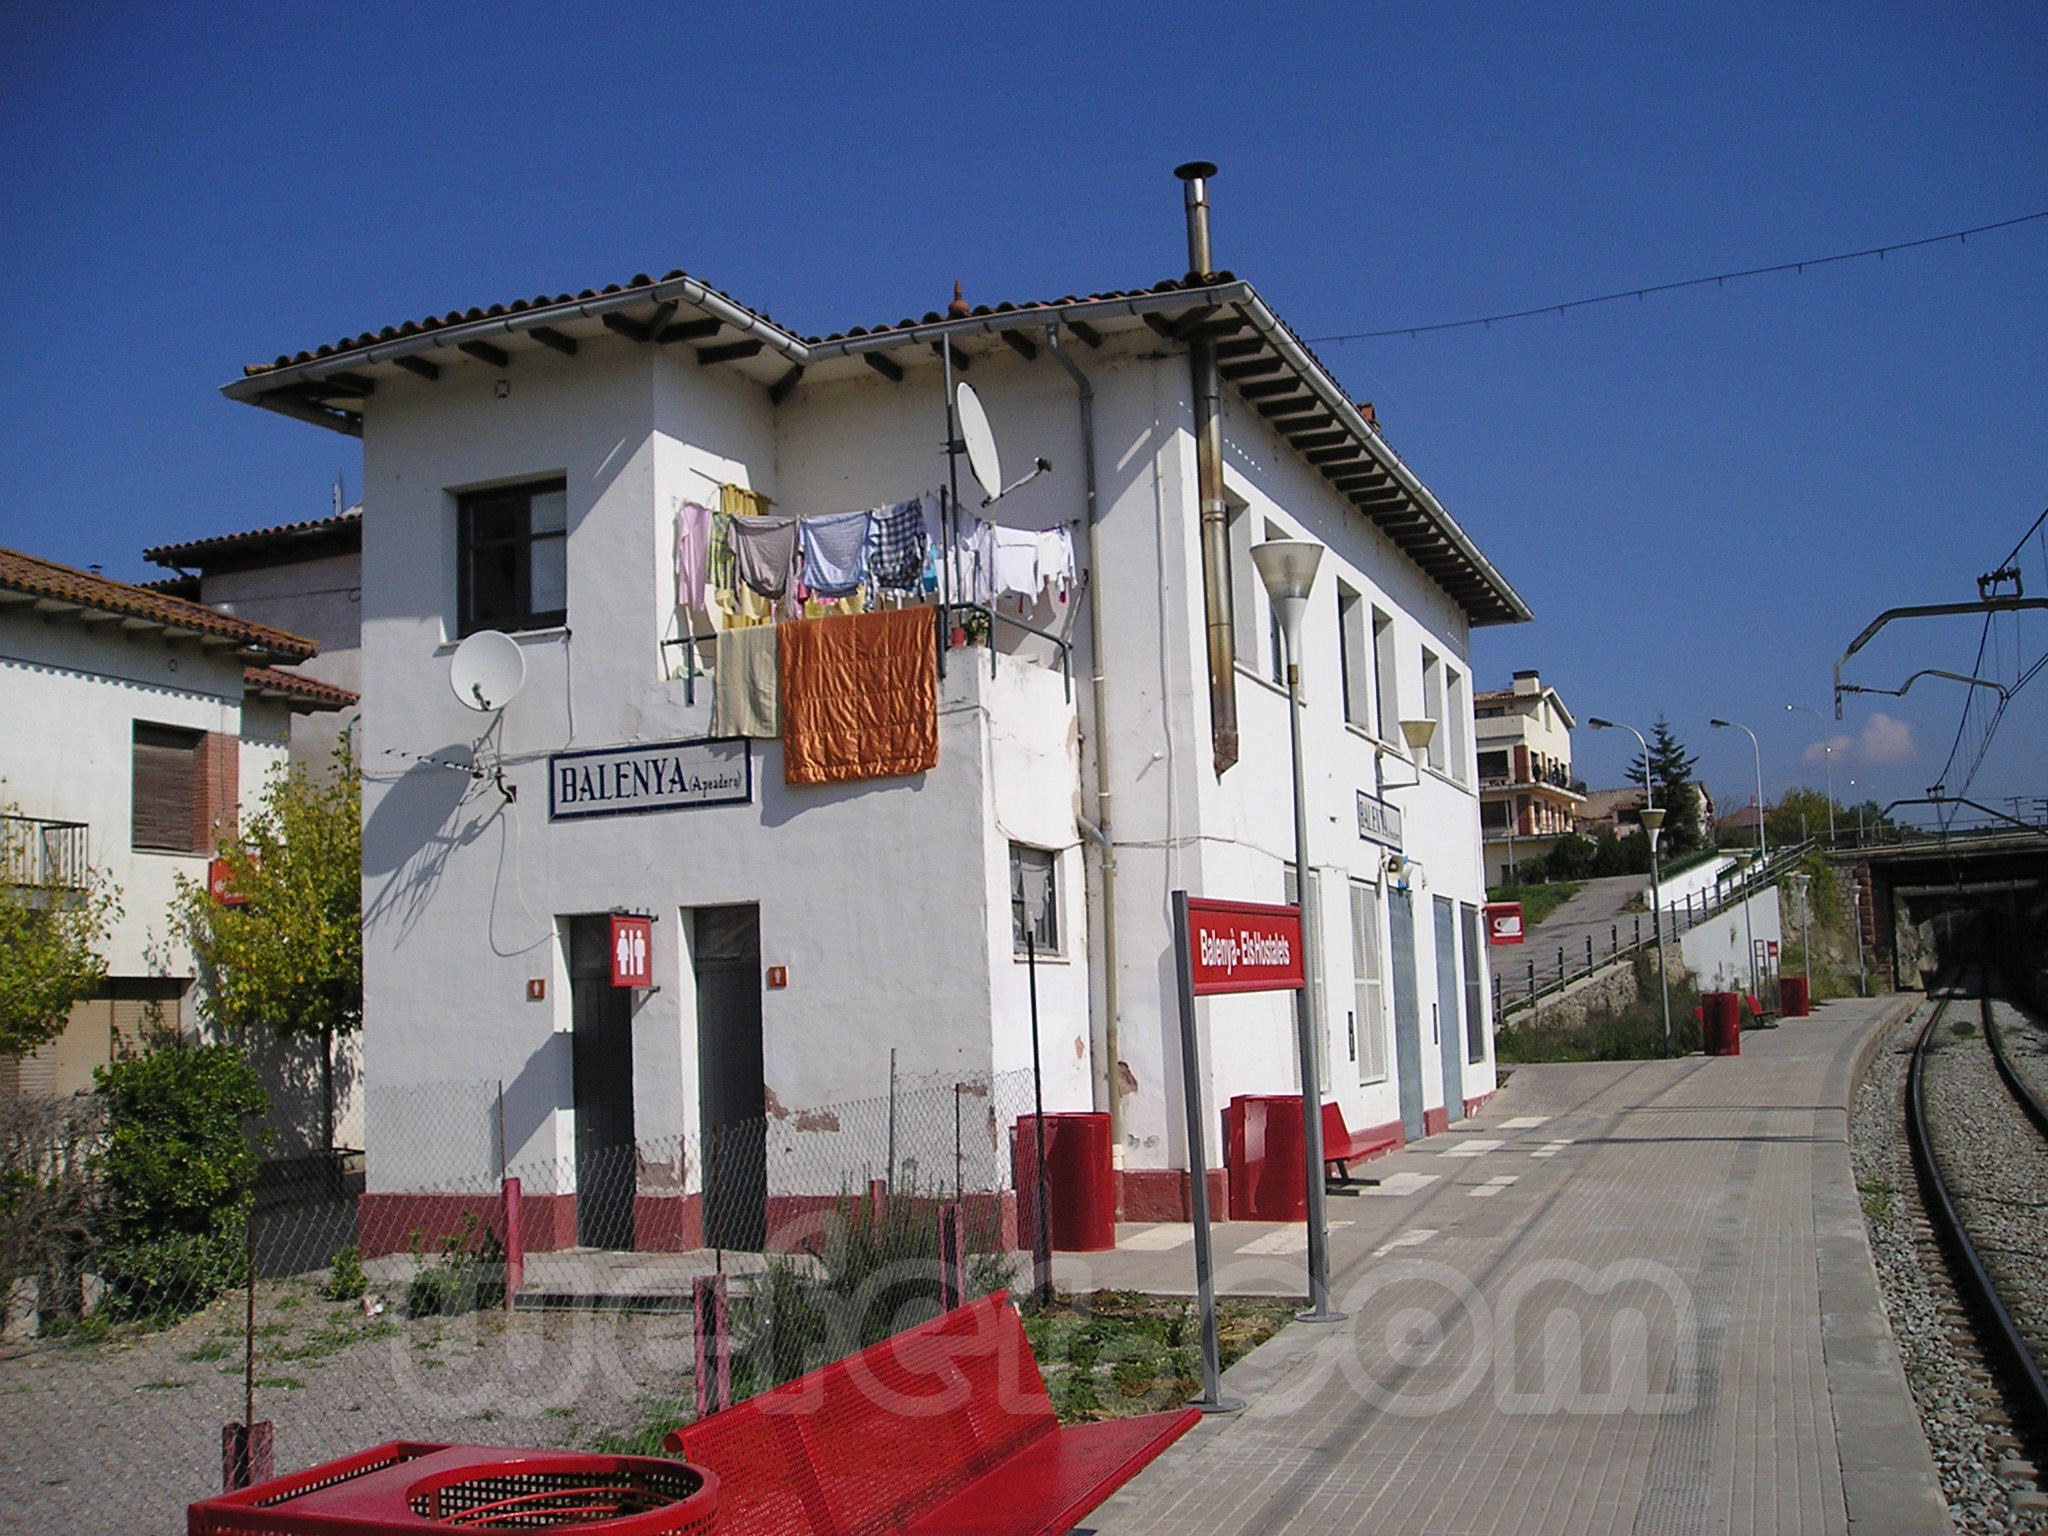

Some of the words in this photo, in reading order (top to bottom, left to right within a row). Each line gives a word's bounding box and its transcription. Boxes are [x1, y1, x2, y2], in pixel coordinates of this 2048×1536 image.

[560, 757, 689, 803] BALENYA
[1240, 930, 1254, 966] Els
[1253, 931, 1290, 966] Hostalets
